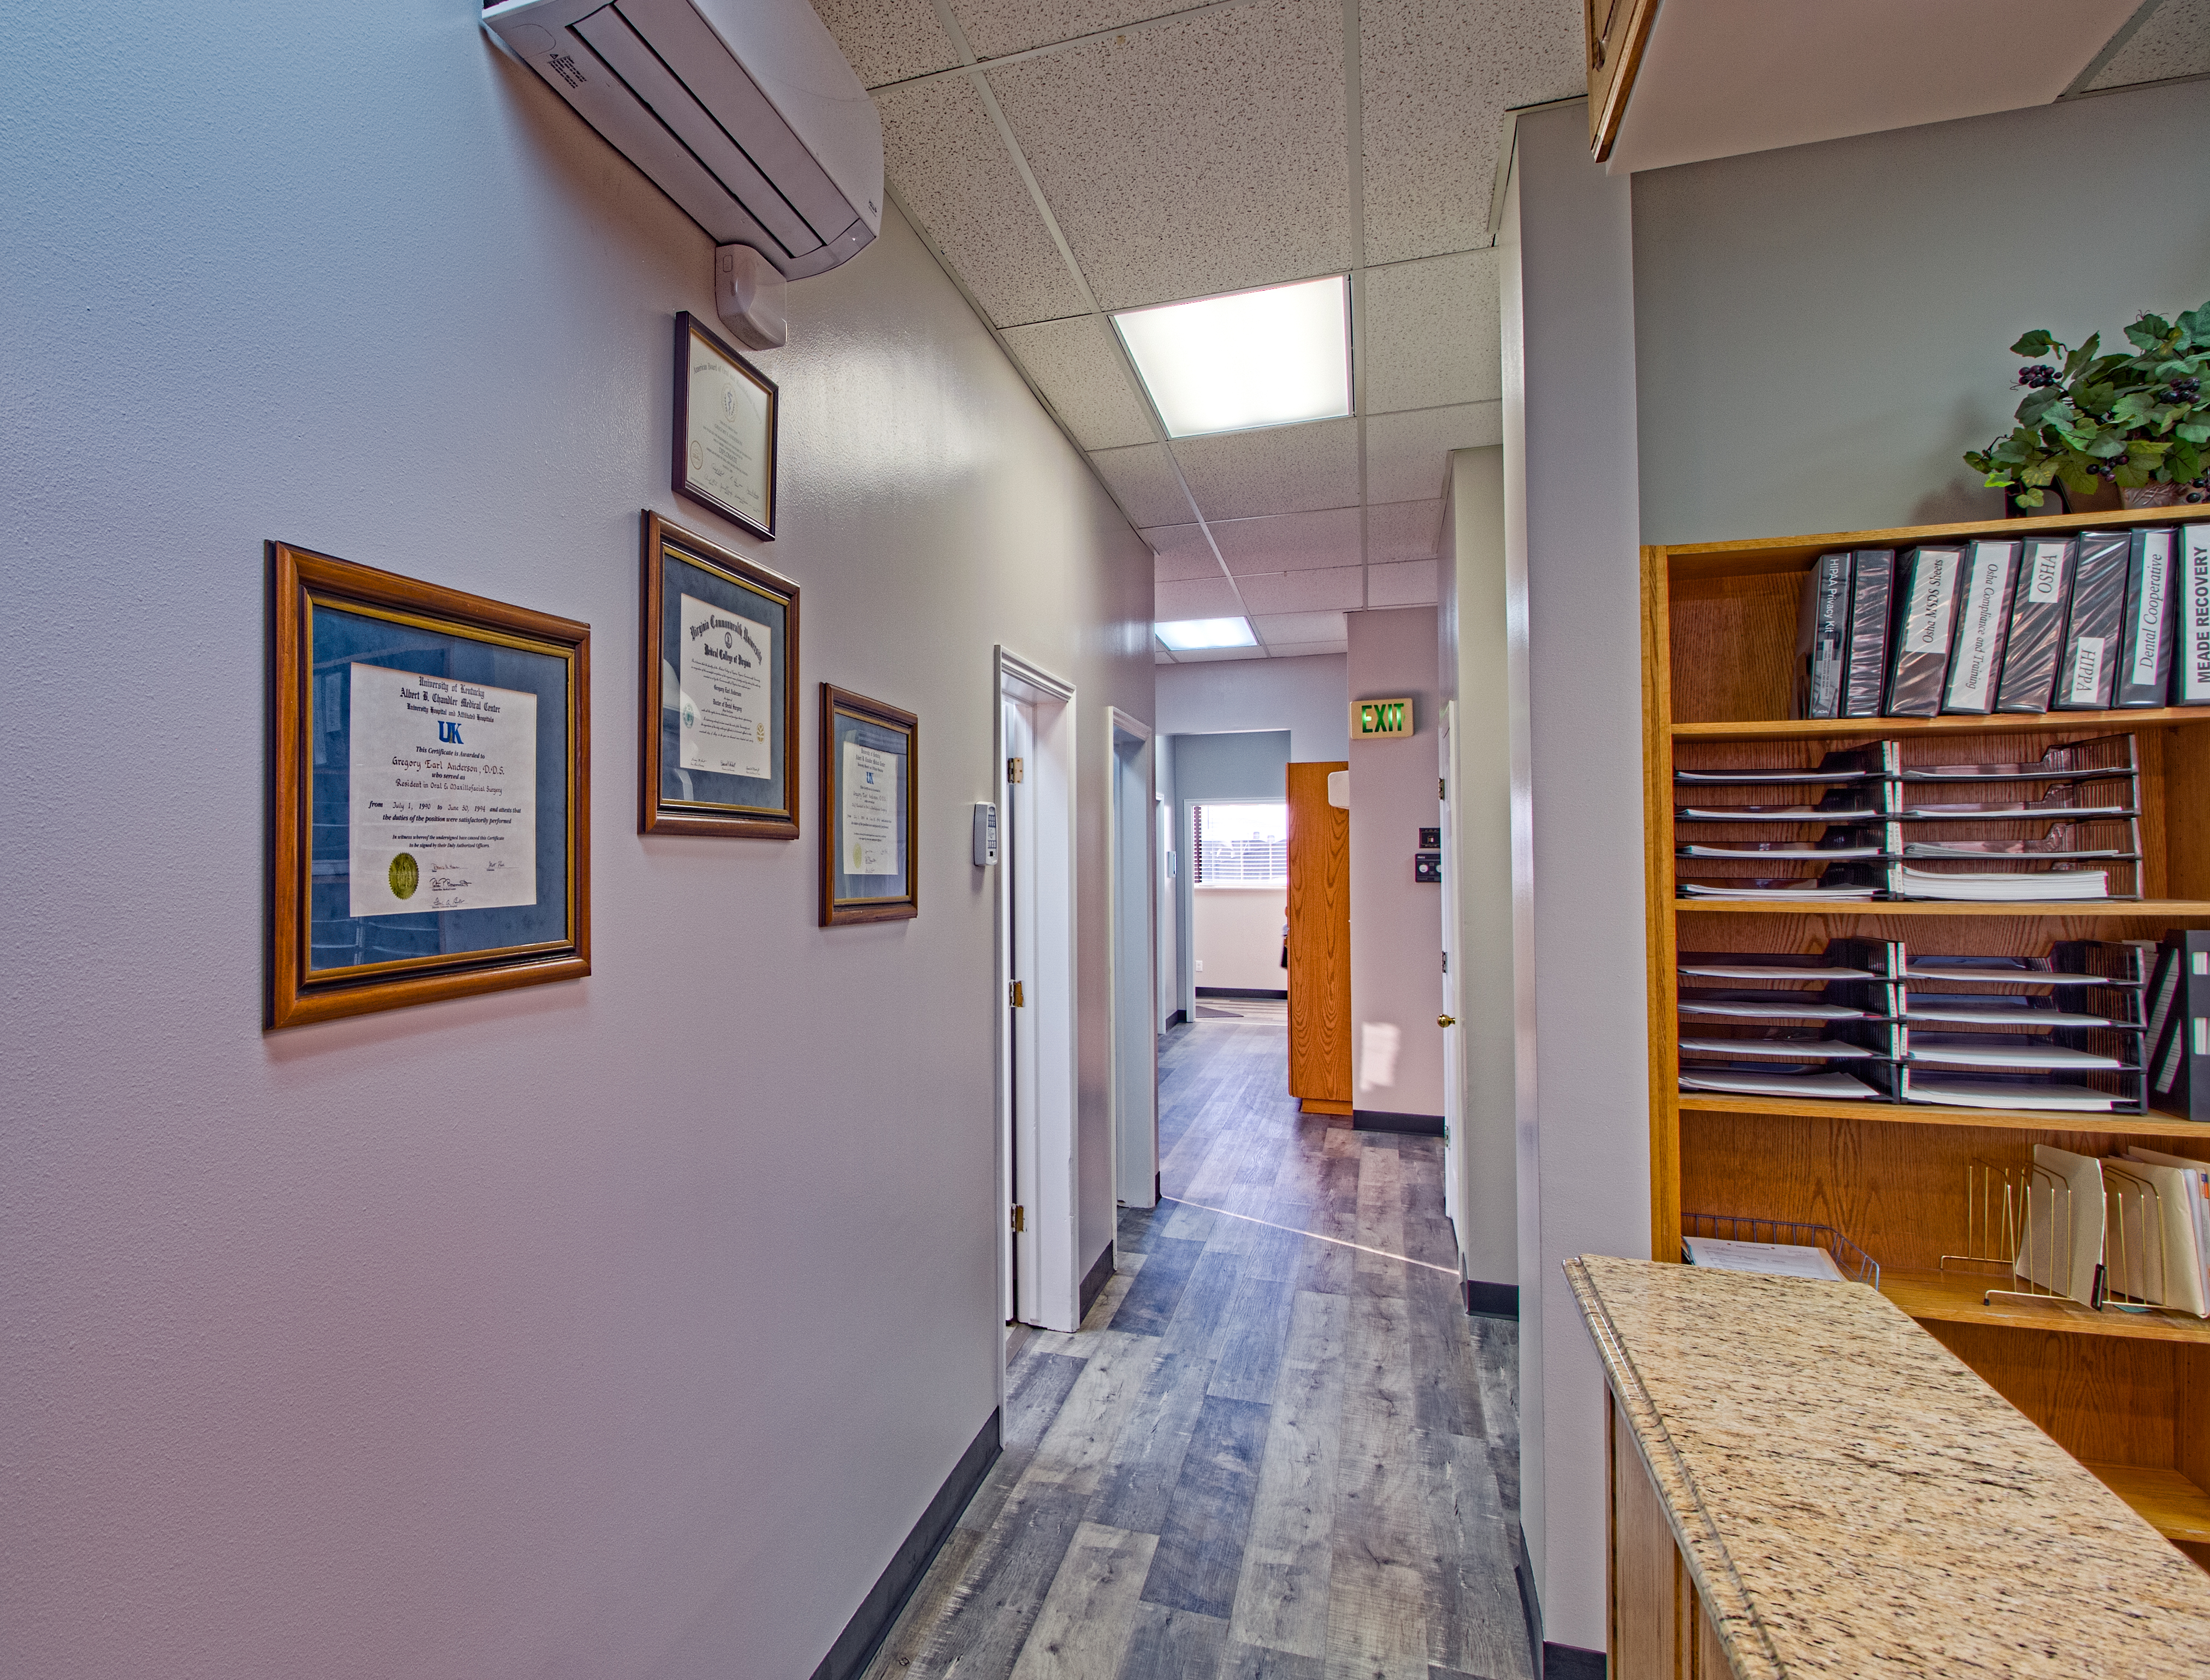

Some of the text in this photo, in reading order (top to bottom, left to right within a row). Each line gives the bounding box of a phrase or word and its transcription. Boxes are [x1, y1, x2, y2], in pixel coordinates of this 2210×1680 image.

[2037, 554, 2057, 594] OSHA
[1824, 559, 1840, 633] HIPAA Privacy Kit
[1922, 559, 1943, 643] Osha MSDS Sheets
[1966, 564, 1998, 690] Osha Compliance and Training
[2140, 554, 2163, 670] Dental Cooperative
[2194, 546, 2210, 683] MEADE RECOVERY
[2076, 648, 2096, 692] HIPPA
[400, 687, 500, 713] Albert B. Chandler Medical Center
[419, 676, 484, 699] University of Kentucky
[438, 720, 464, 744] UK
[1361, 703, 1404, 733] EXIT
[392, 756, 421, 772] Gregory
[424, 760, 442, 770] Earl
[482, 765, 505, 775] D.D.S.
[428, 748, 453, 756] Certificate
[395, 778, 422, 788] Resident
[450, 784, 485, 792] Maxillofacial
[486, 786, 503, 796] Surgery
[393, 802, 404, 812] July
